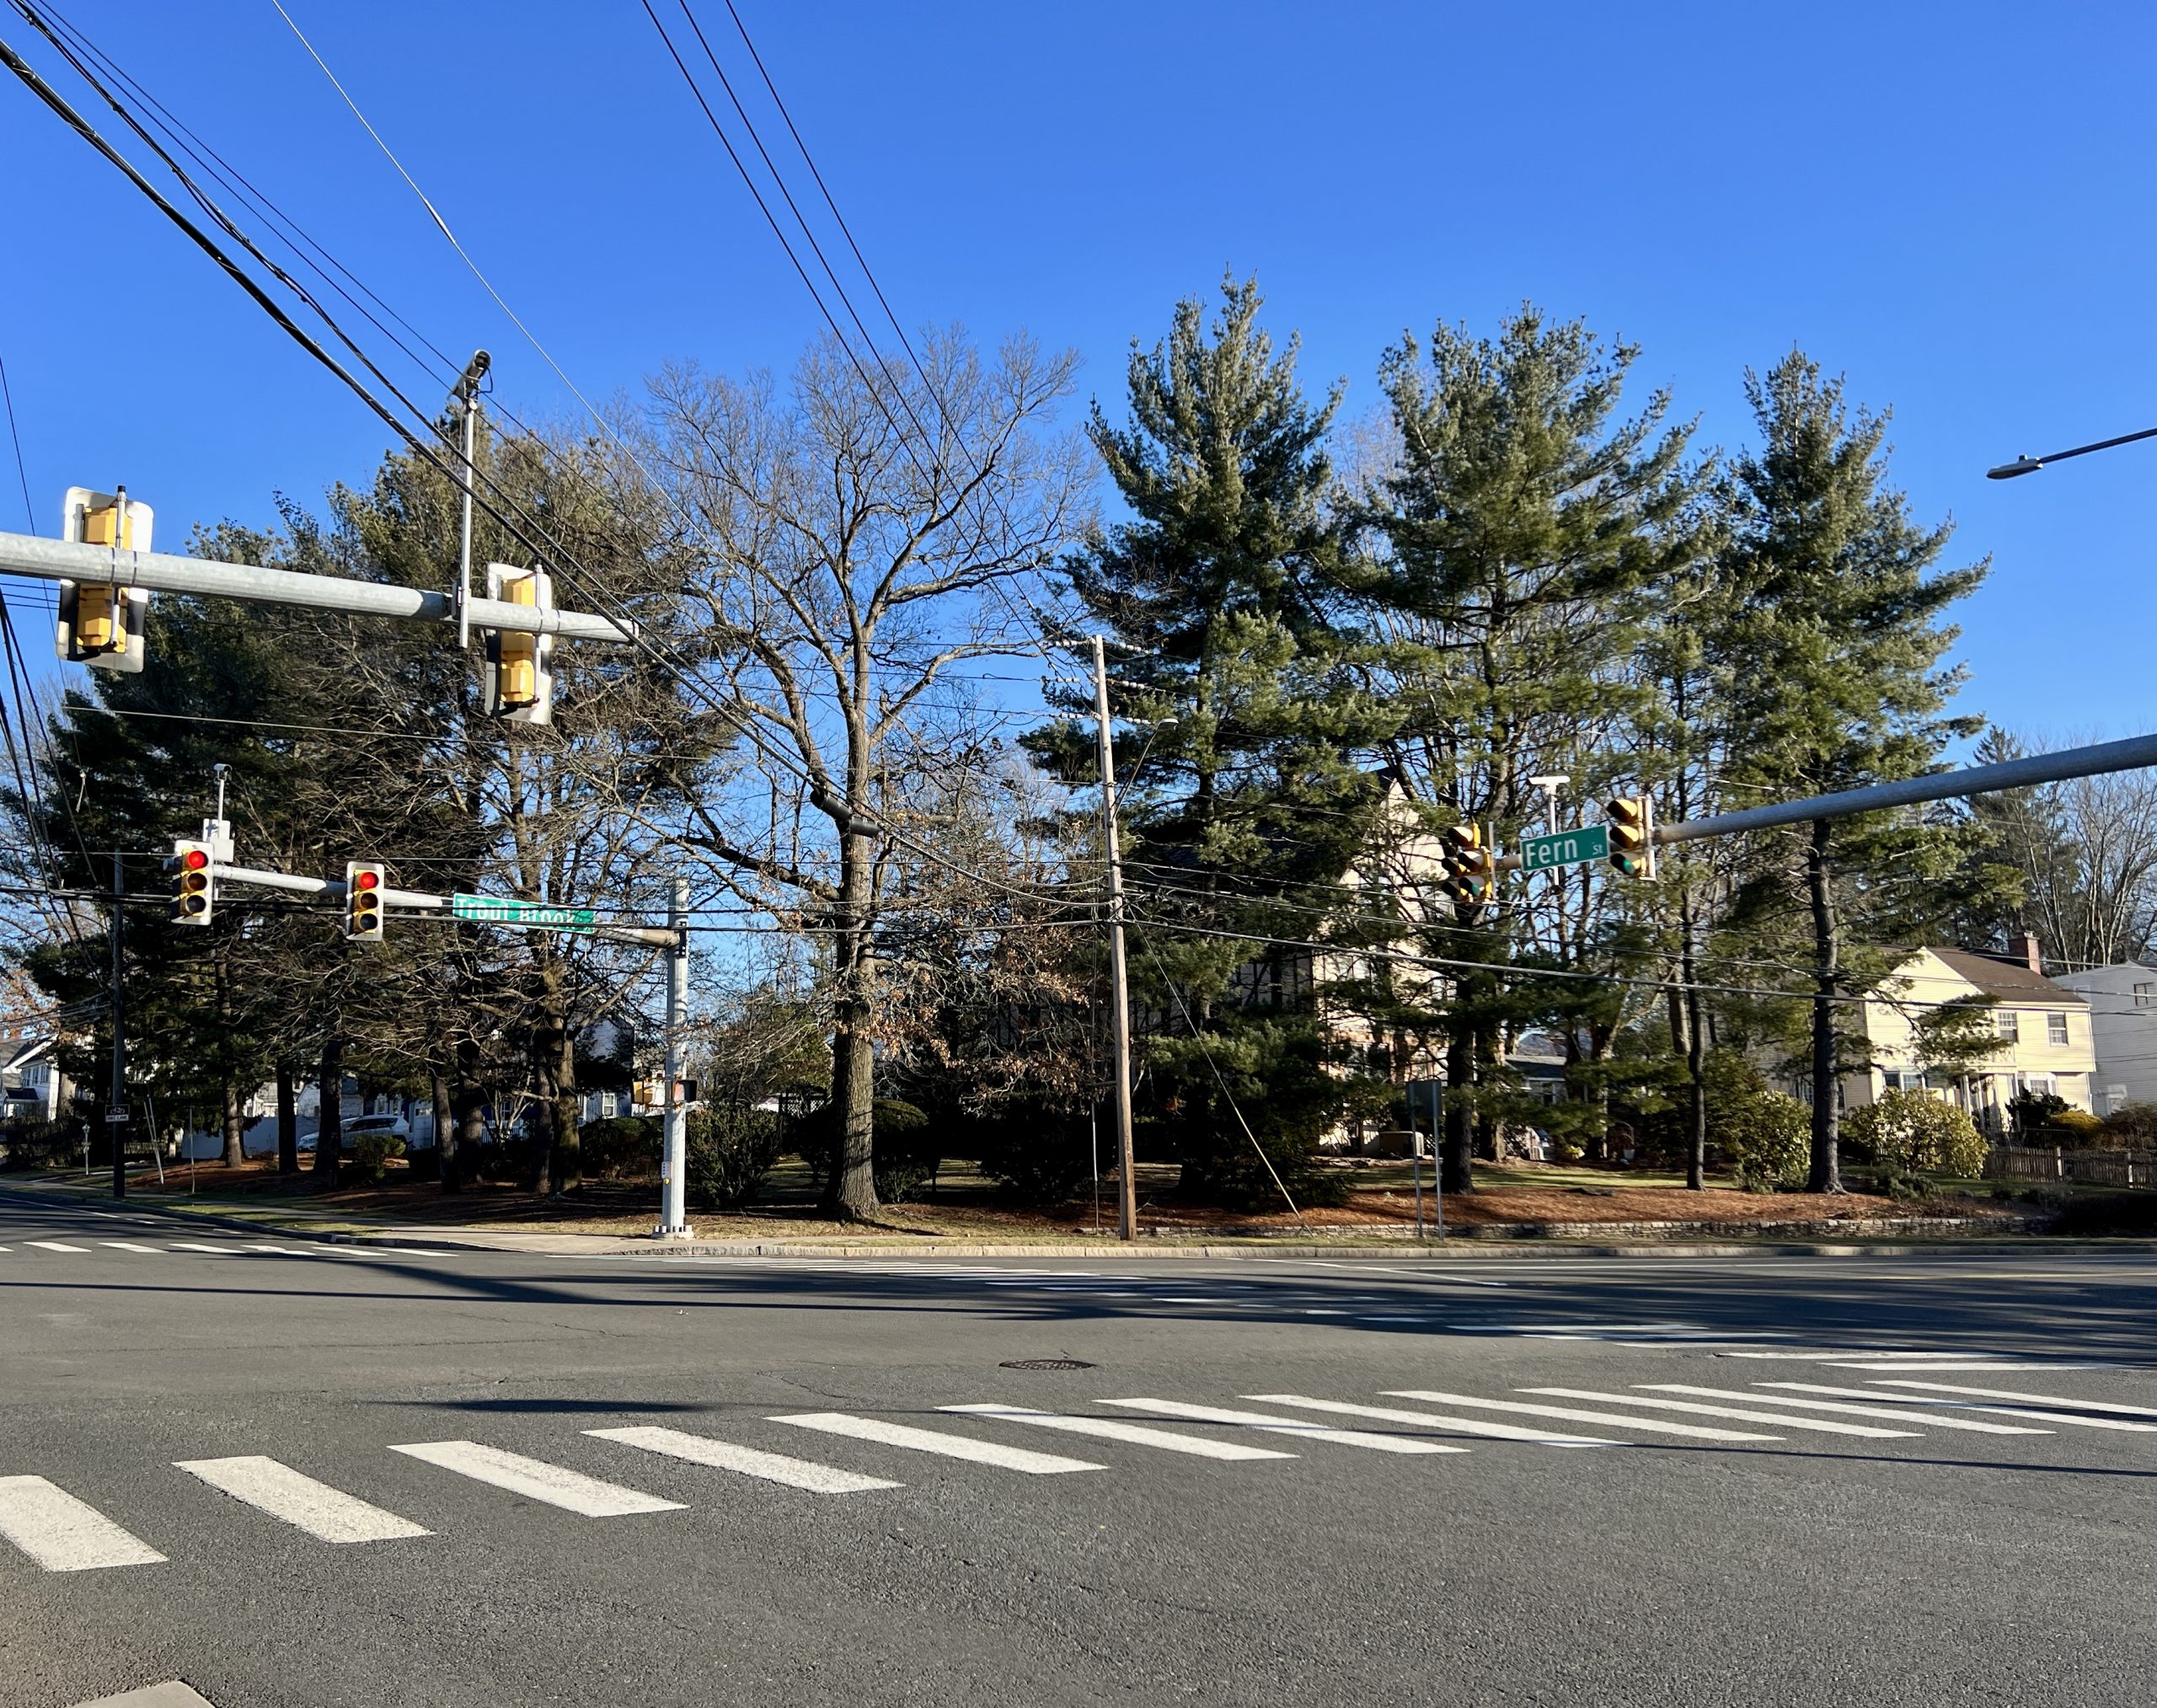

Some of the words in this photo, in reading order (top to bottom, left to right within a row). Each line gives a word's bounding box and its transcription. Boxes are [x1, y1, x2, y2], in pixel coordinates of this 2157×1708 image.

[1525, 838, 1578, 867] Fern
[1592, 843, 1604, 855] St
[457, 899, 509, 921] Trout
